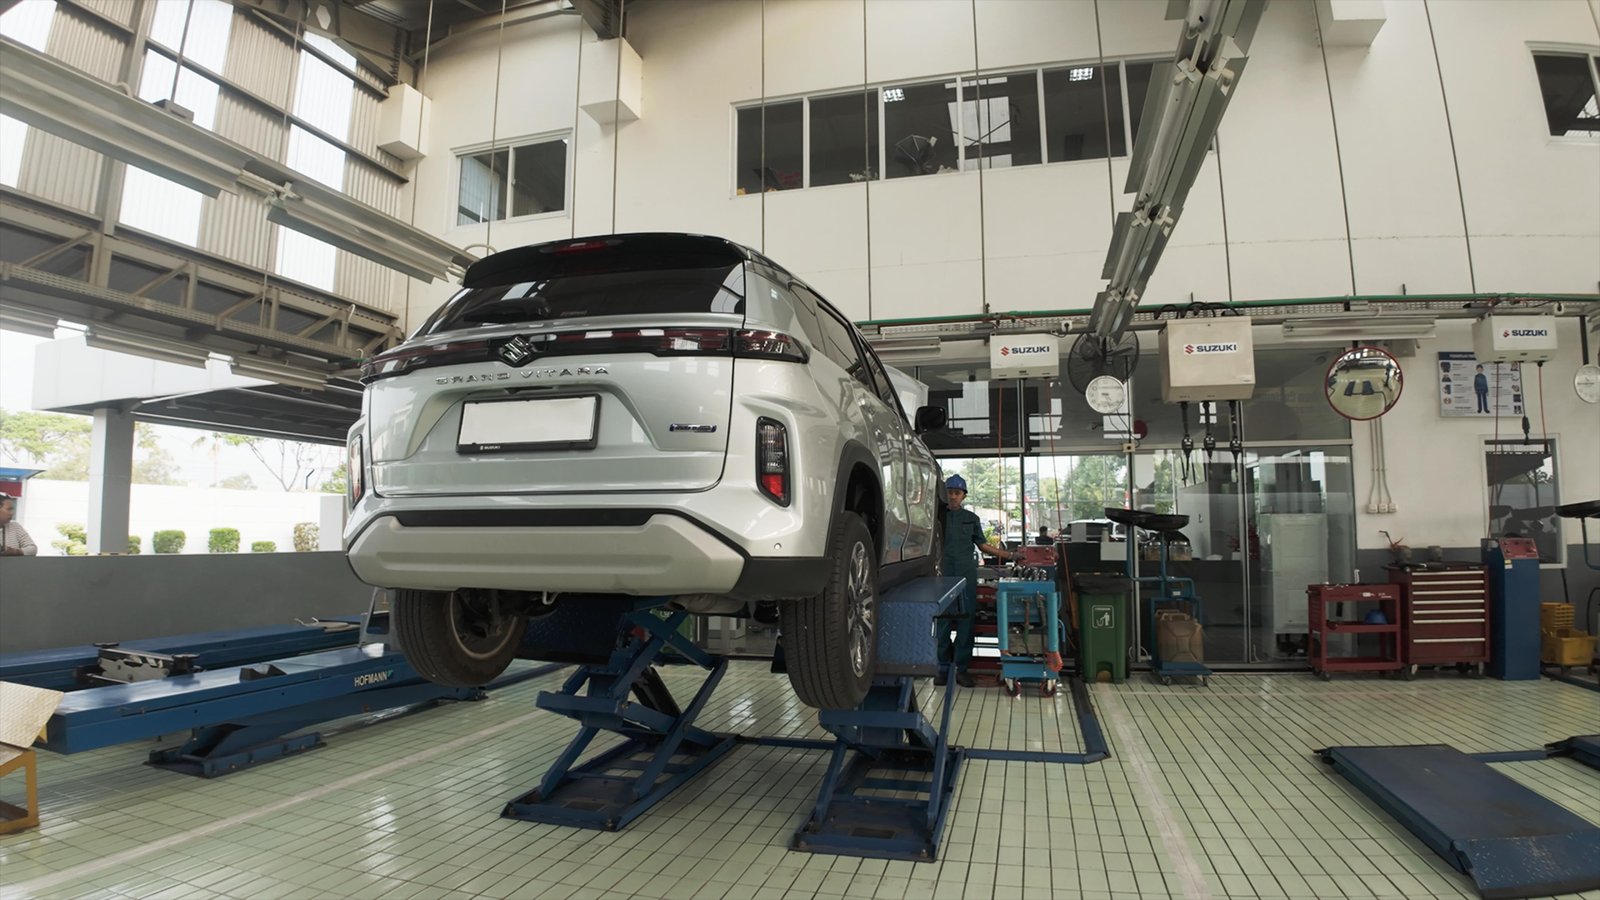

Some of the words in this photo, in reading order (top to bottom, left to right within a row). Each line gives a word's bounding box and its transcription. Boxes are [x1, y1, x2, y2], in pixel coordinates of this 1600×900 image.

[1511, 329, 1548, 337] SUZUKI
[1011, 346, 1050, 354] SUZUKI
[1196, 344, 1237, 353] SUZUKI
[435, 372, 511, 385] GRAND
[520, 366, 609, 379] VITARA
[354, 671, 388, 687] HOFMANN
